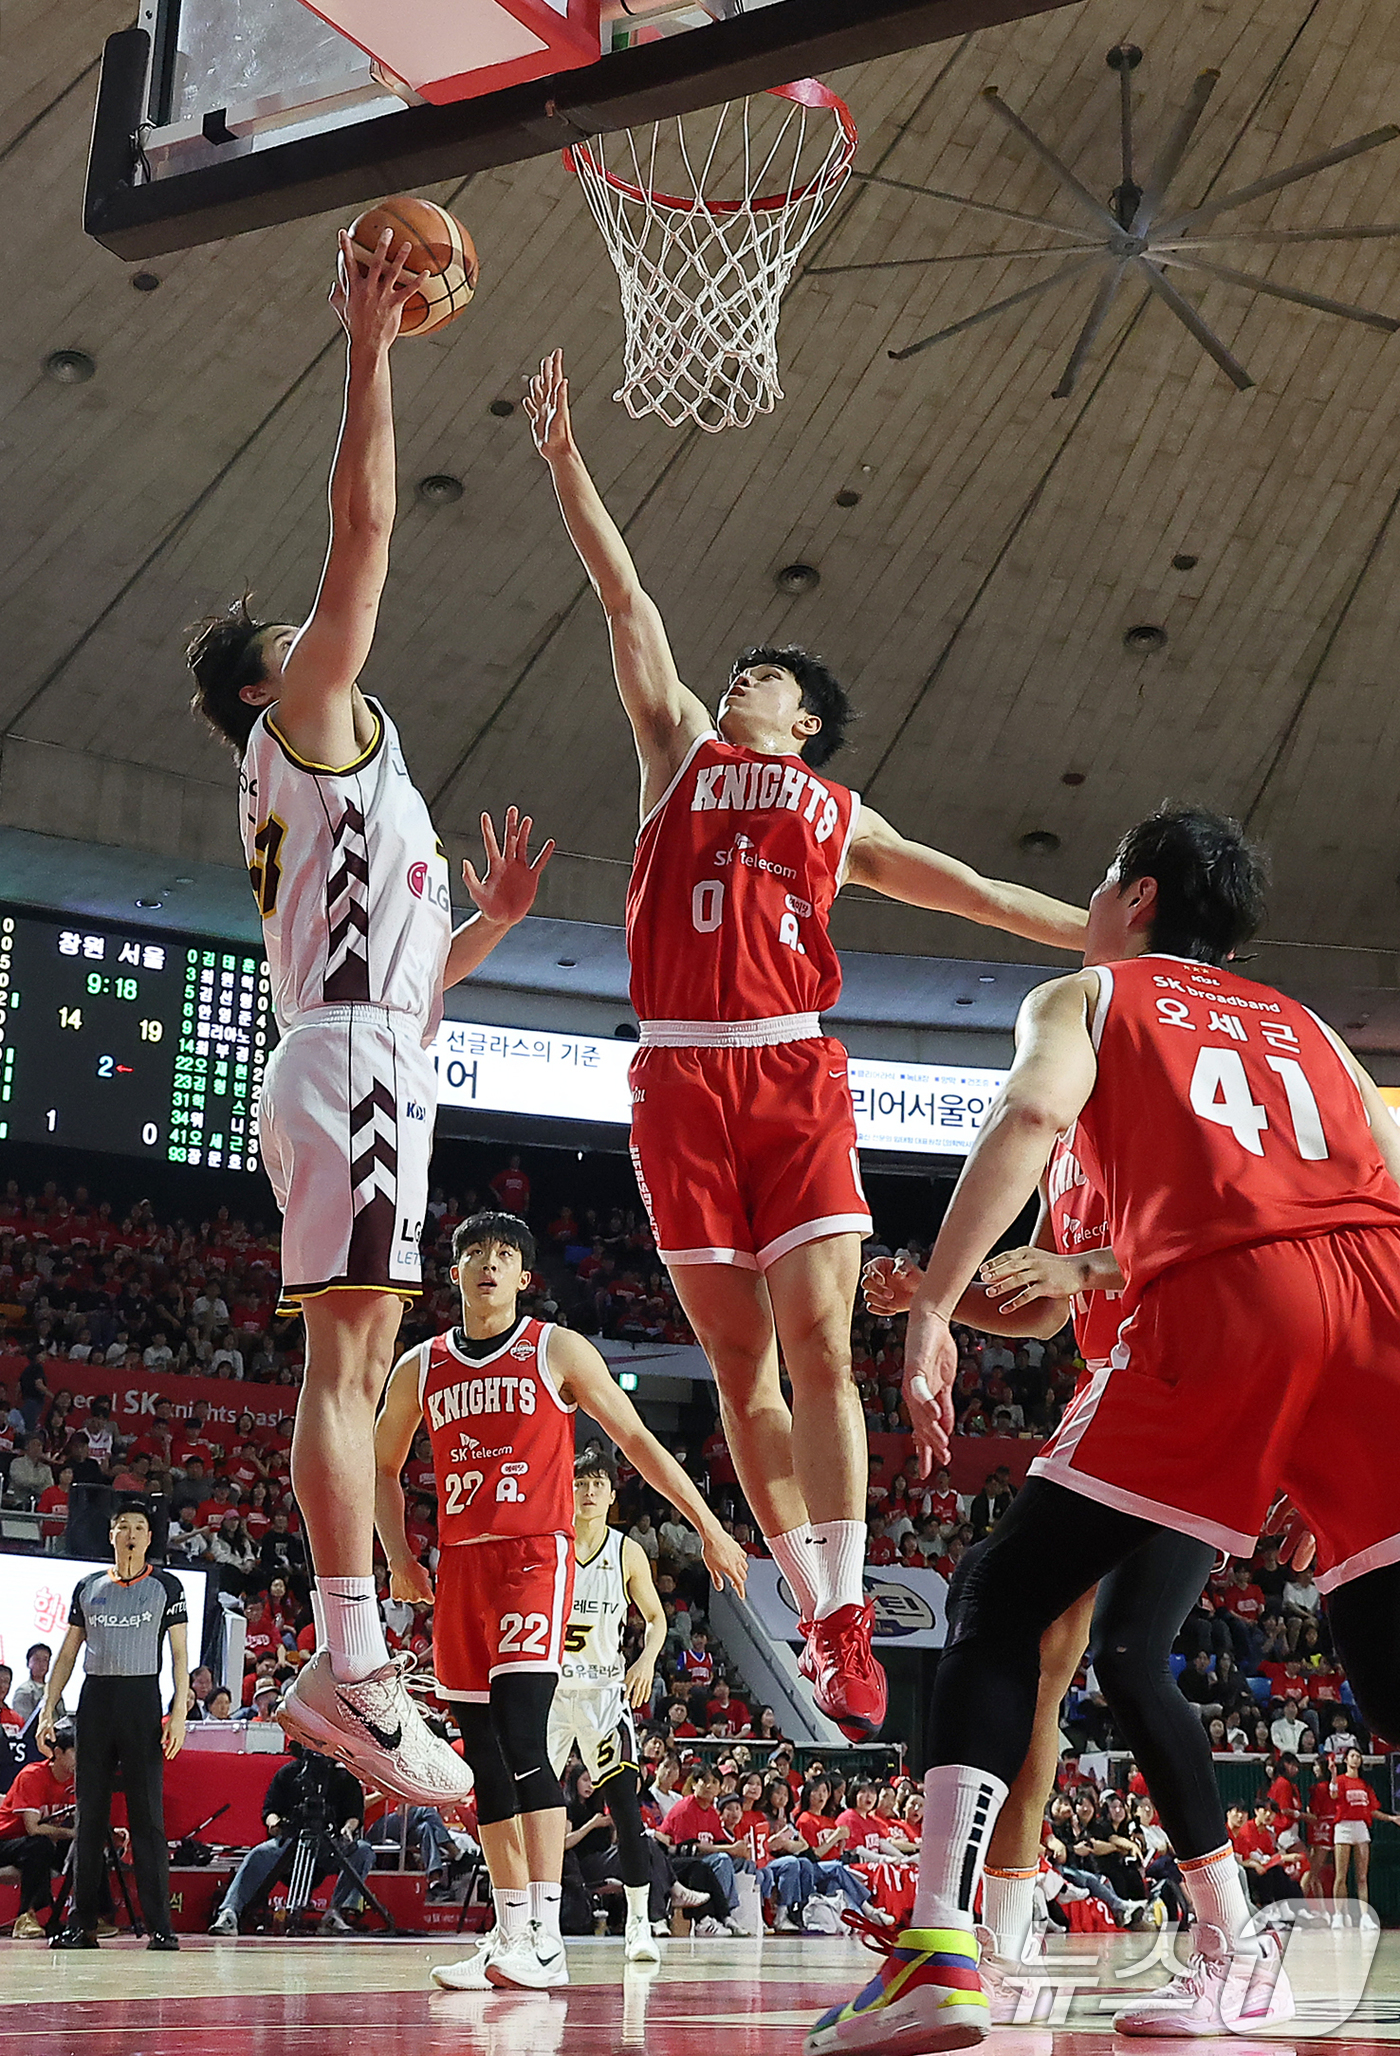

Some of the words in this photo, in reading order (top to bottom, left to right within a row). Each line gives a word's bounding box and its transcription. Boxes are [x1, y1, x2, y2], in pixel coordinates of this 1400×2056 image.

[691, 763, 839, 843] KNIGHTS
[740, 850, 797, 879] telecom
[693, 879, 724, 933] 0
[3, 917, 15, 933] 0
[1, 936, 13, 951] 0
[58, 931, 105, 959] 창원
[118, 941, 165, 970] 서울
[187, 949, 198, 964] 0
[260, 961, 271, 976] 0
[87, 973, 138, 1001] 9:18
[186, 966, 196, 981] 3
[259, 979, 269, 993] 0
[184, 985, 195, 999] 5
[257, 996, 268, 1011] 0
[1152, 976, 1185, 993] SK
[1186, 985, 1281, 1013] broadband
[58, 1006, 83, 1030] 14
[183, 1002, 193, 1017] 8
[256, 1014, 266, 1029] 4
[139, 1019, 163, 1042] 19
[182, 1020, 192, 1035] 9
[255, 1031, 266, 1046] 0
[178, 1037, 194, 1053] 14
[254, 1049, 265, 1064] 5
[447, 1030, 551, 1063] 선글라스의
[561, 1044, 601, 1068] 기준
[98, 1055, 114, 1077] 2
[174, 1055, 193, 1072] 22
[253, 1067, 264, 1082] 2
[173, 1073, 192, 1089] 23
[172, 1091, 190, 1108] 31
[1189, 1046, 1329, 1160] 41
[46, 1109, 57, 1131] 1
[170, 1110, 189, 1126] 34
[142, 1122, 158, 1145] 0
[169, 1128, 187, 1144] 41
[247, 1138, 258, 1154] 3
[168, 1146, 187, 1162] 93
[246, 1156, 258, 1172] 0
[123, 1389, 160, 1415] SK
[428, 1377, 537, 1431] KNIGHTS
[450, 1448, 468, 1462] SK
[471, 1446, 513, 1460] telecom
[88, 1614, 142, 1628] 바이오스타
[602, 1602, 619, 1614] TV
[498, 1612, 549, 1654] 22
[564, 1623, 594, 1653] 5
